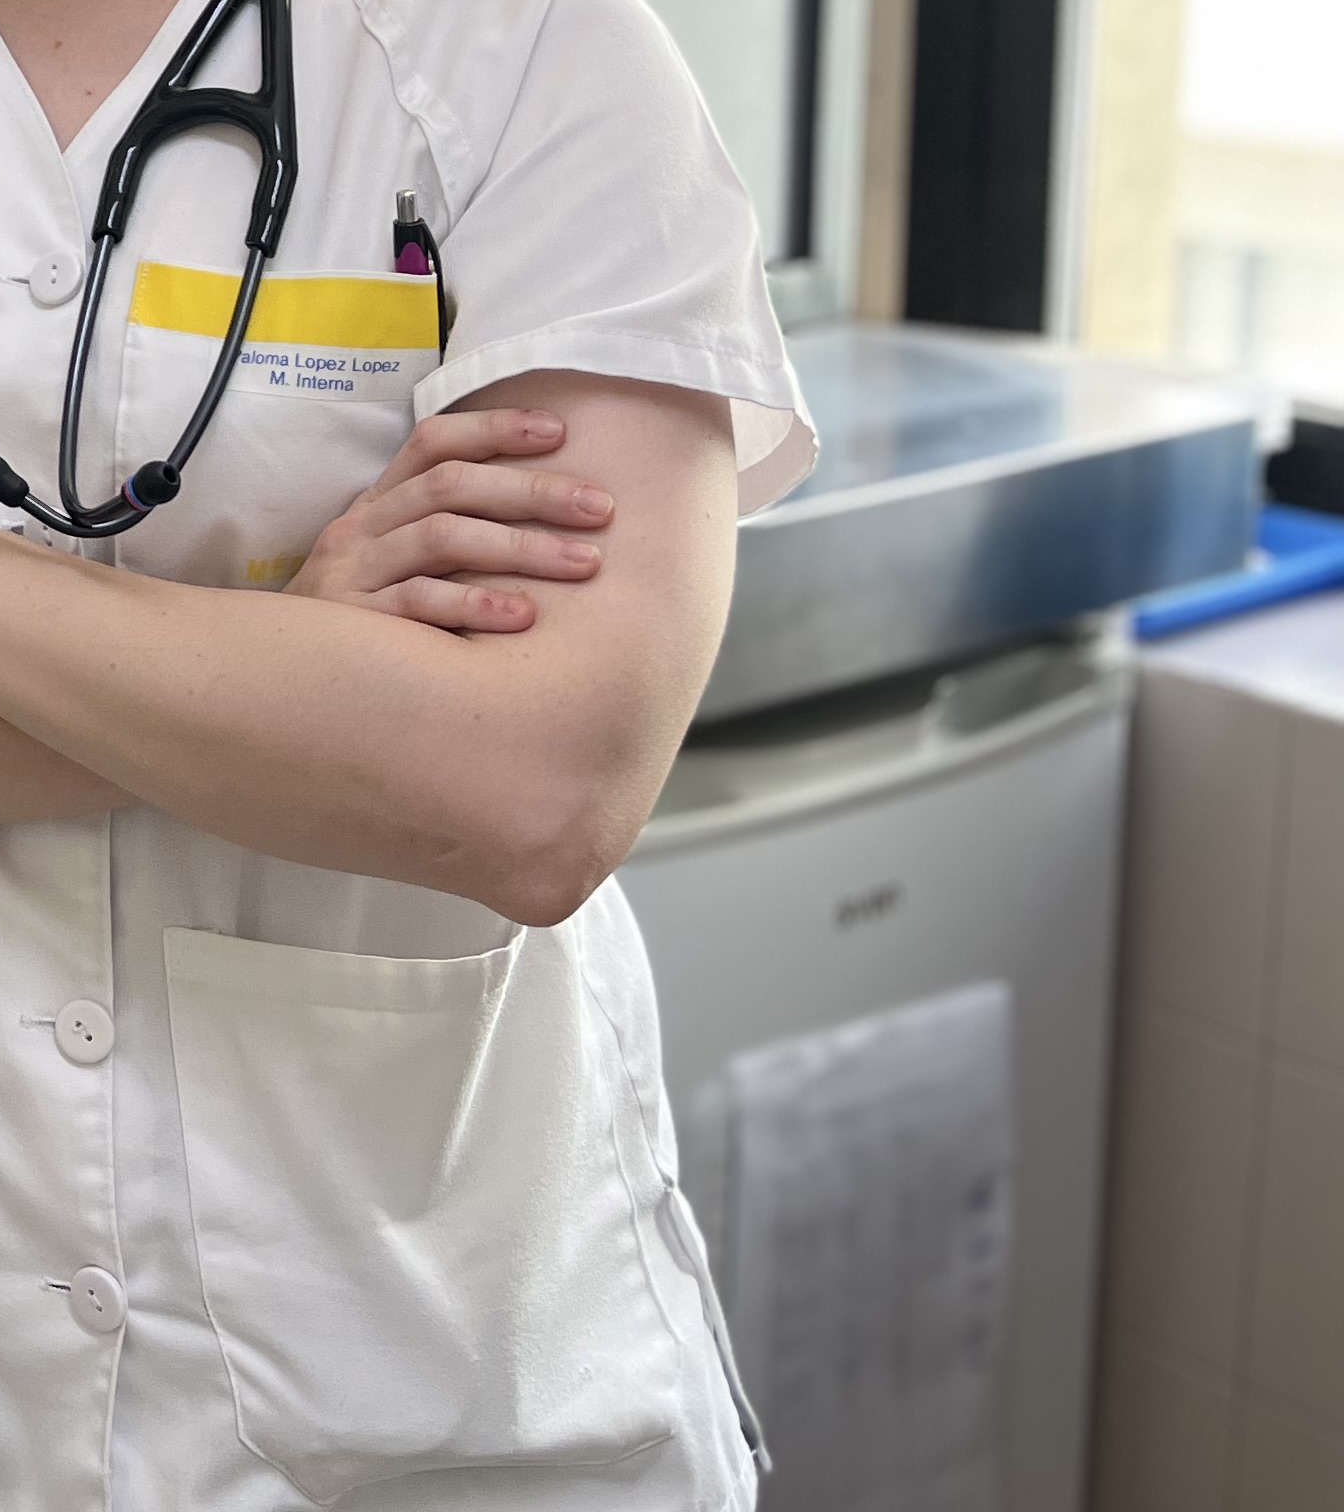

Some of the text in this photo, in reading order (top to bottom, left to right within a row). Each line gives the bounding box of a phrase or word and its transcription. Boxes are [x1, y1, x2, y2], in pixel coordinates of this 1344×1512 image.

[238, 350, 400, 375] aloma Lopez Lopez
[269, 370, 354, 392] M. Interna
